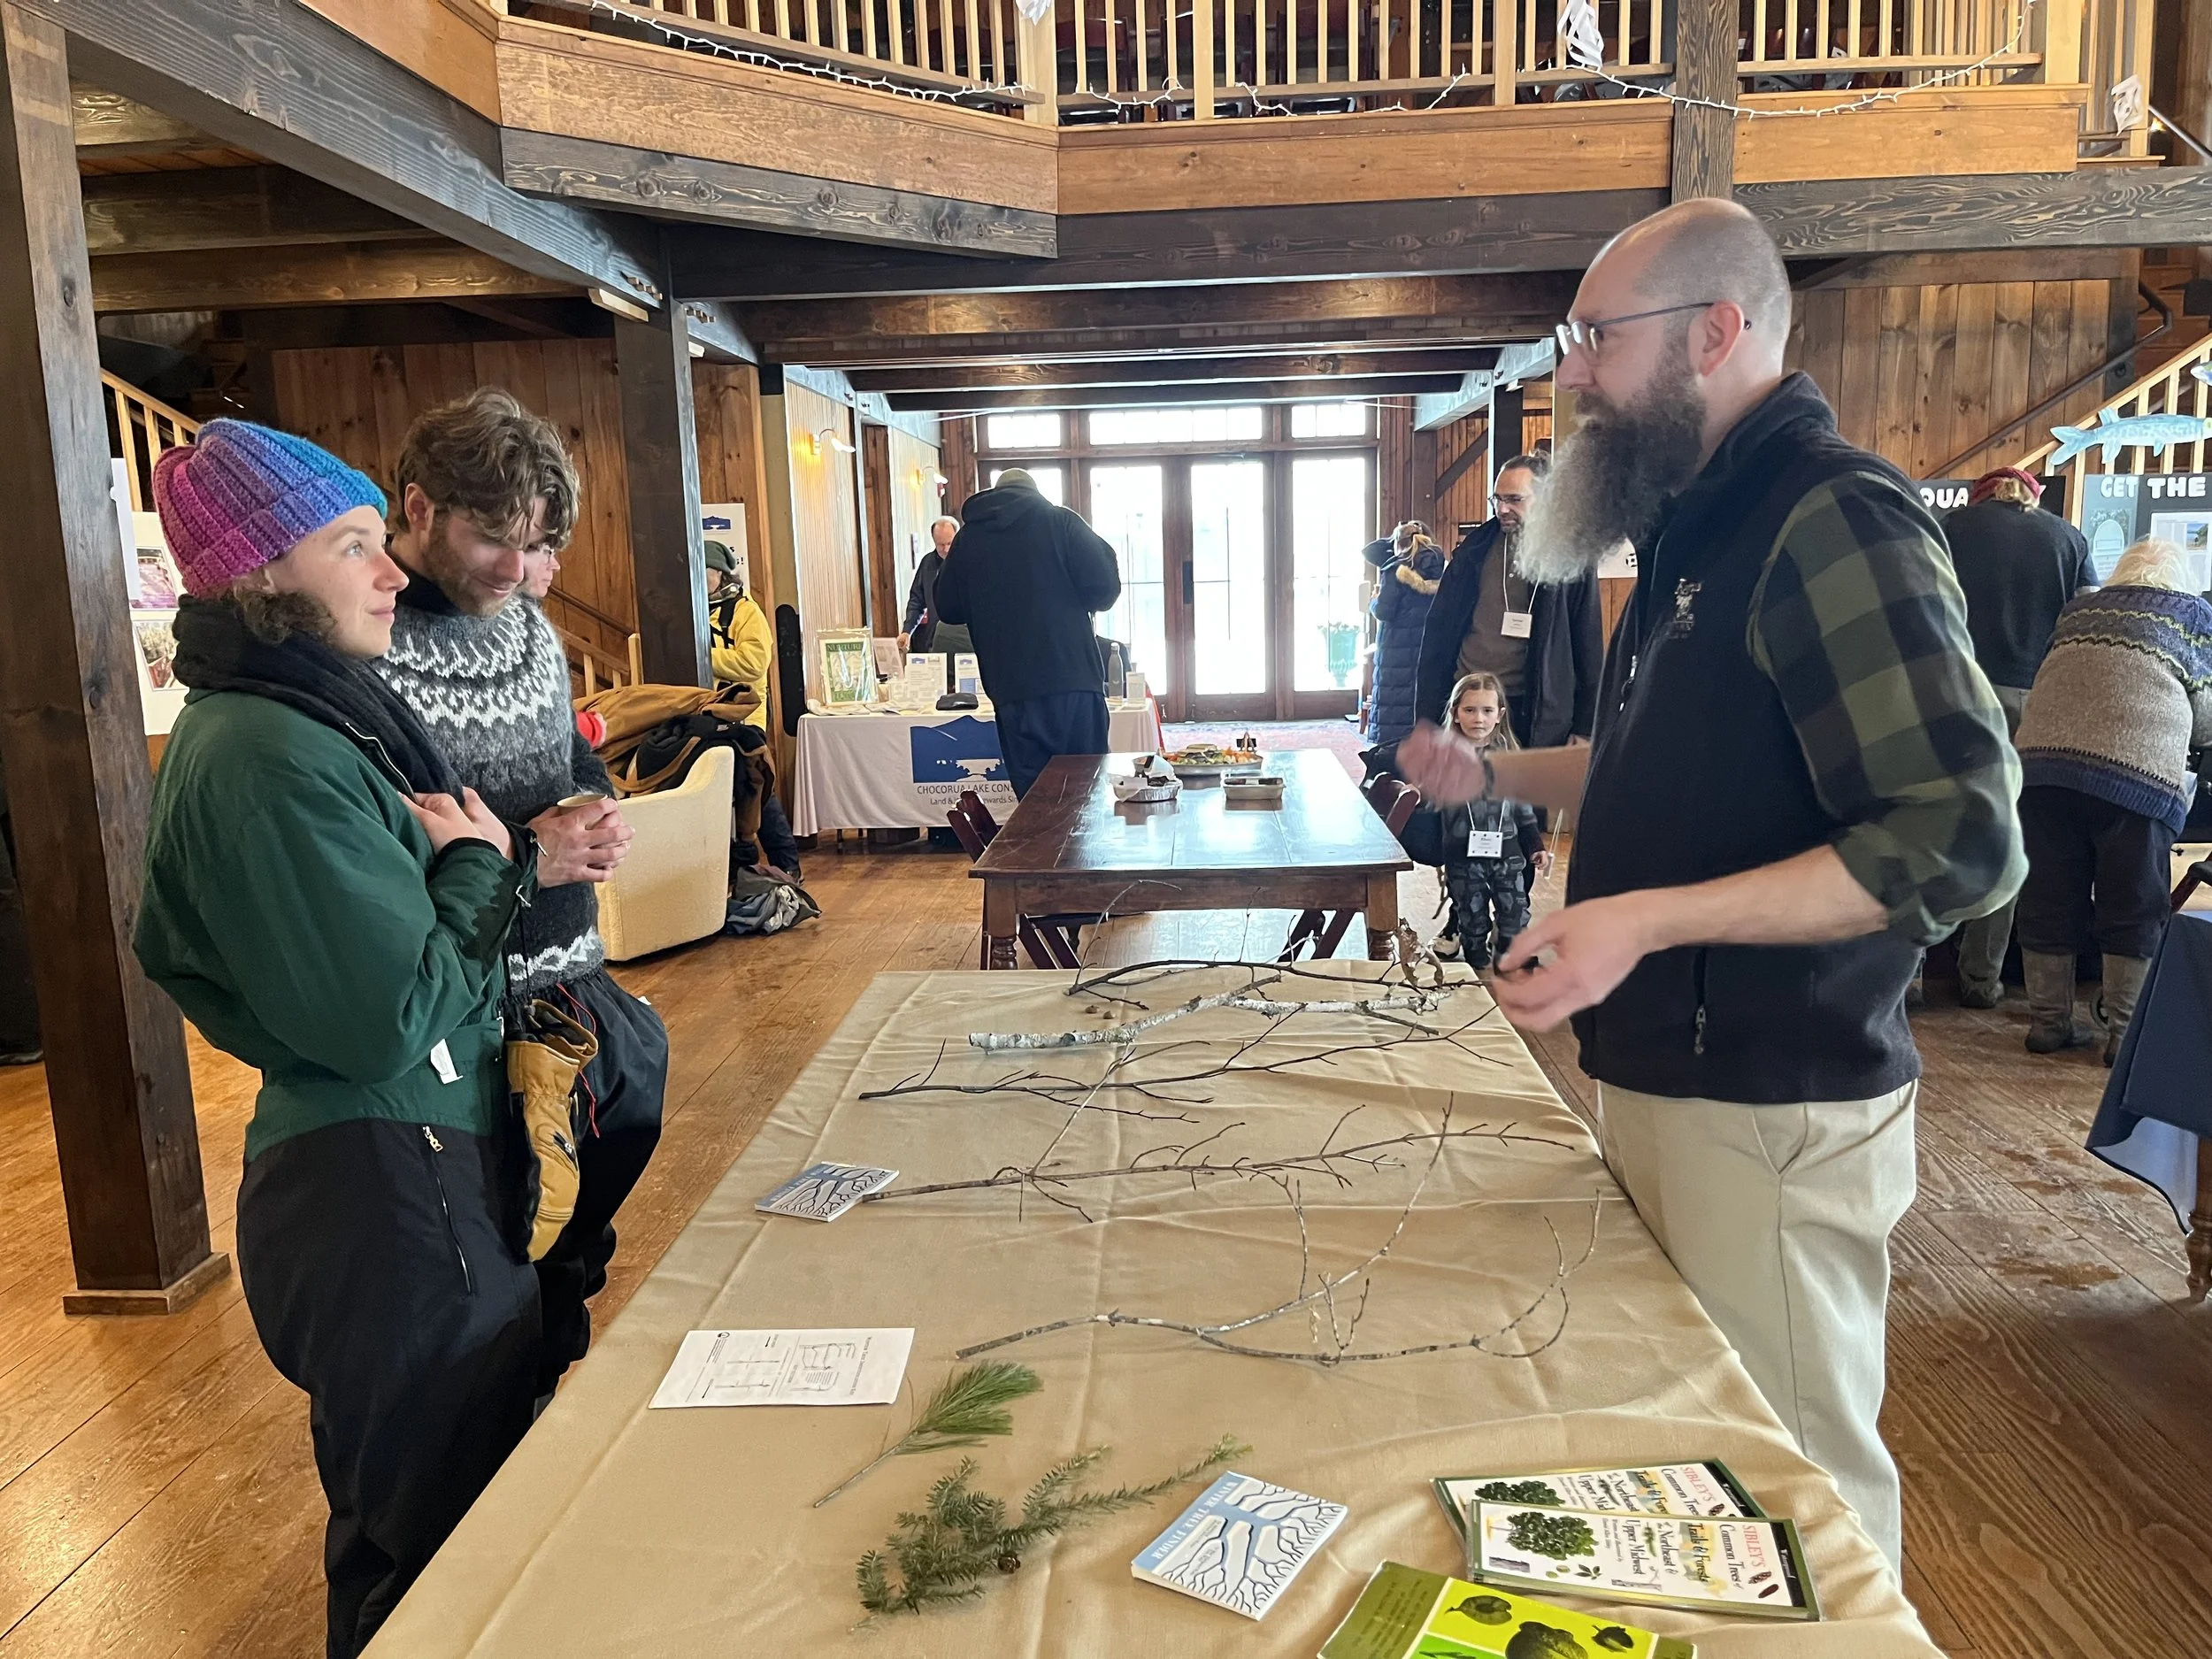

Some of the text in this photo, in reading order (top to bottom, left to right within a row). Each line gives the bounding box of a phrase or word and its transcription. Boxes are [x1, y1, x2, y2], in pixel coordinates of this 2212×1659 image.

[2101, 476, 2206, 498] GET THE
[1662, 1468, 1688, 1499] Common
[1622, 1519, 1649, 1575] Upper Midwest
[1659, 1531, 1680, 1566] Northeast
[1687, 1523, 1709, 1545] Trails
[1742, 1525, 1766, 1568] SIBLEY'S
[1694, 1555, 1711, 1583] Forests
[1719, 1524, 1736, 1560] Common
[1728, 1561, 1746, 1583] Trees
